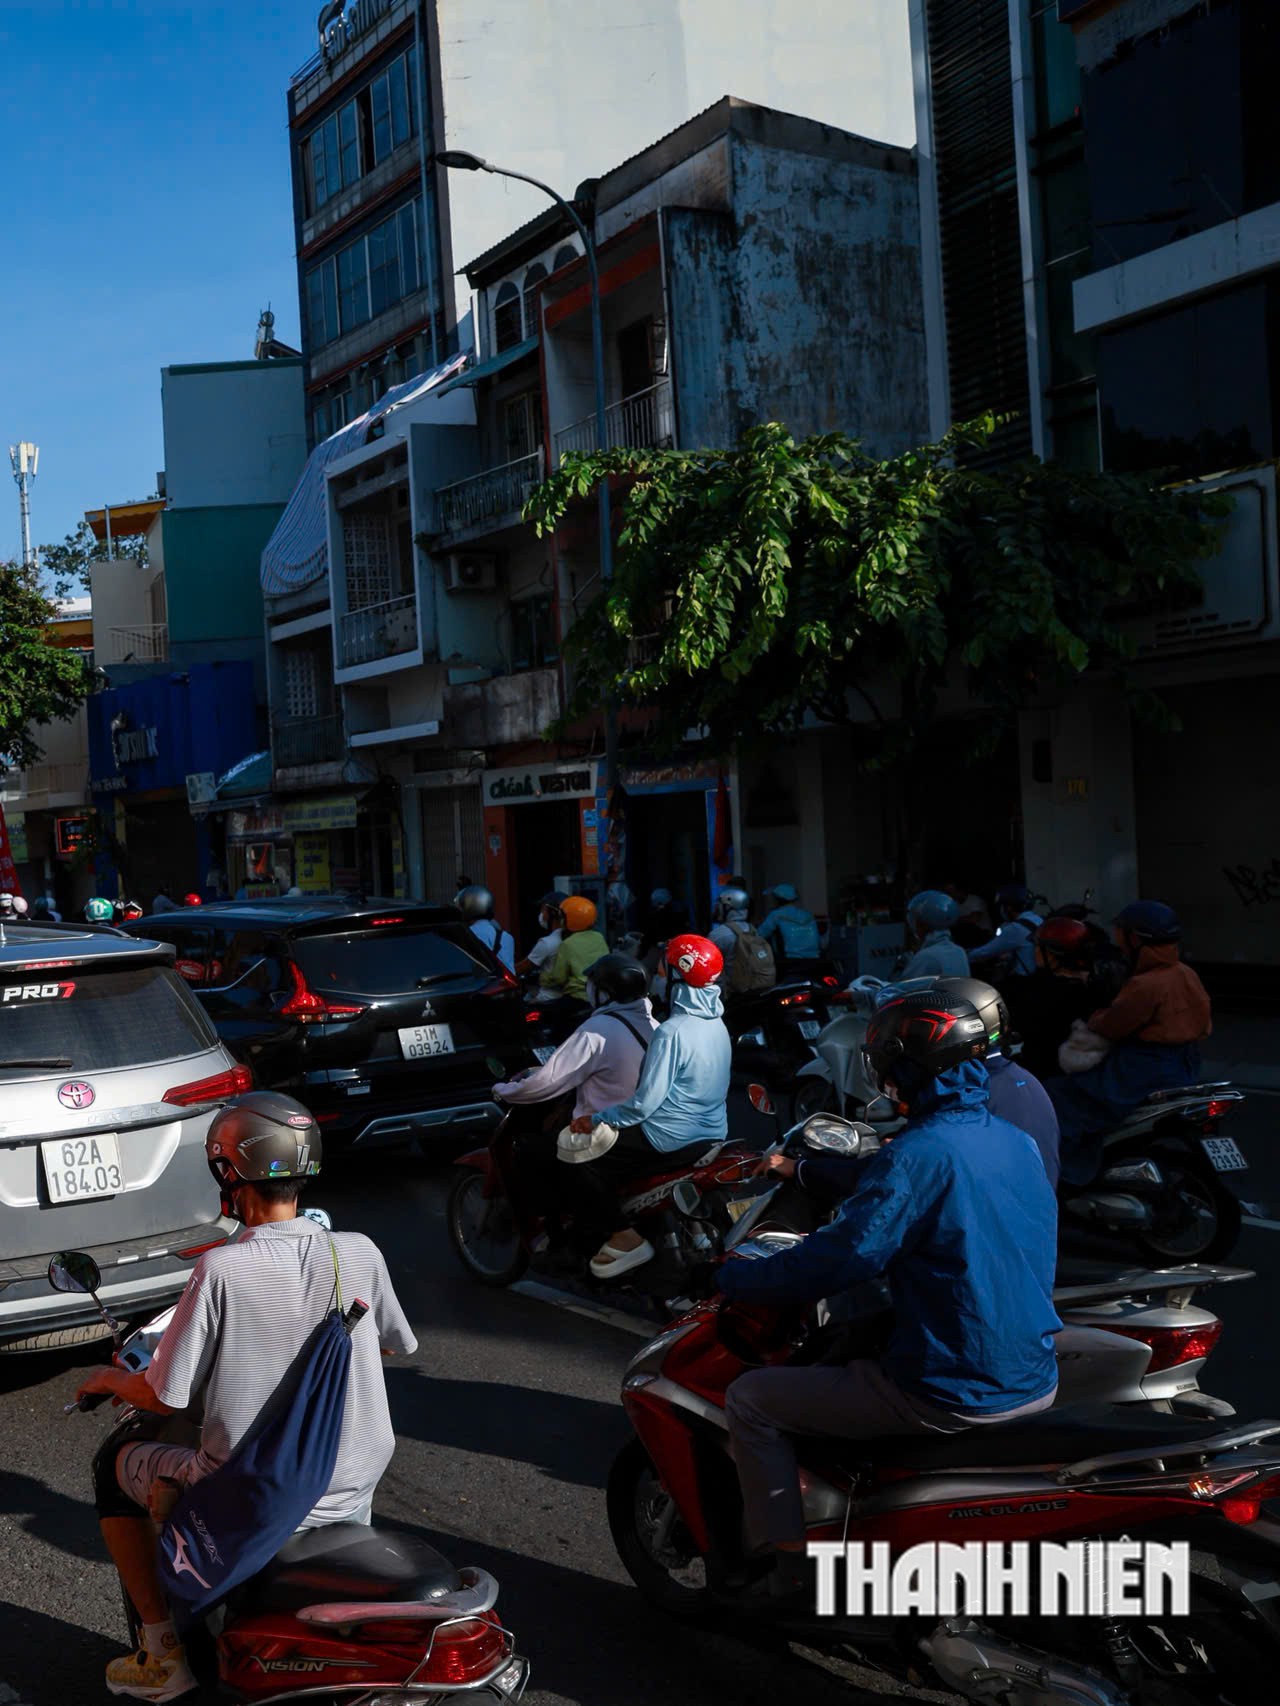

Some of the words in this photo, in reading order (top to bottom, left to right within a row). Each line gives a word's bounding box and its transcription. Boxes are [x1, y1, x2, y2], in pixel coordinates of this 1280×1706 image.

[3, 981, 76, 1001] PRO7
[415, 1029, 438, 1042] 51M
[409, 1041, 450, 1057] 039.24
[61, 1139, 103, 1167] 62A
[52, 1165, 122, 1198] 184.03
[989, 1498, 1068, 1517] BLADE
[250, 1656, 326, 1673] VISION
